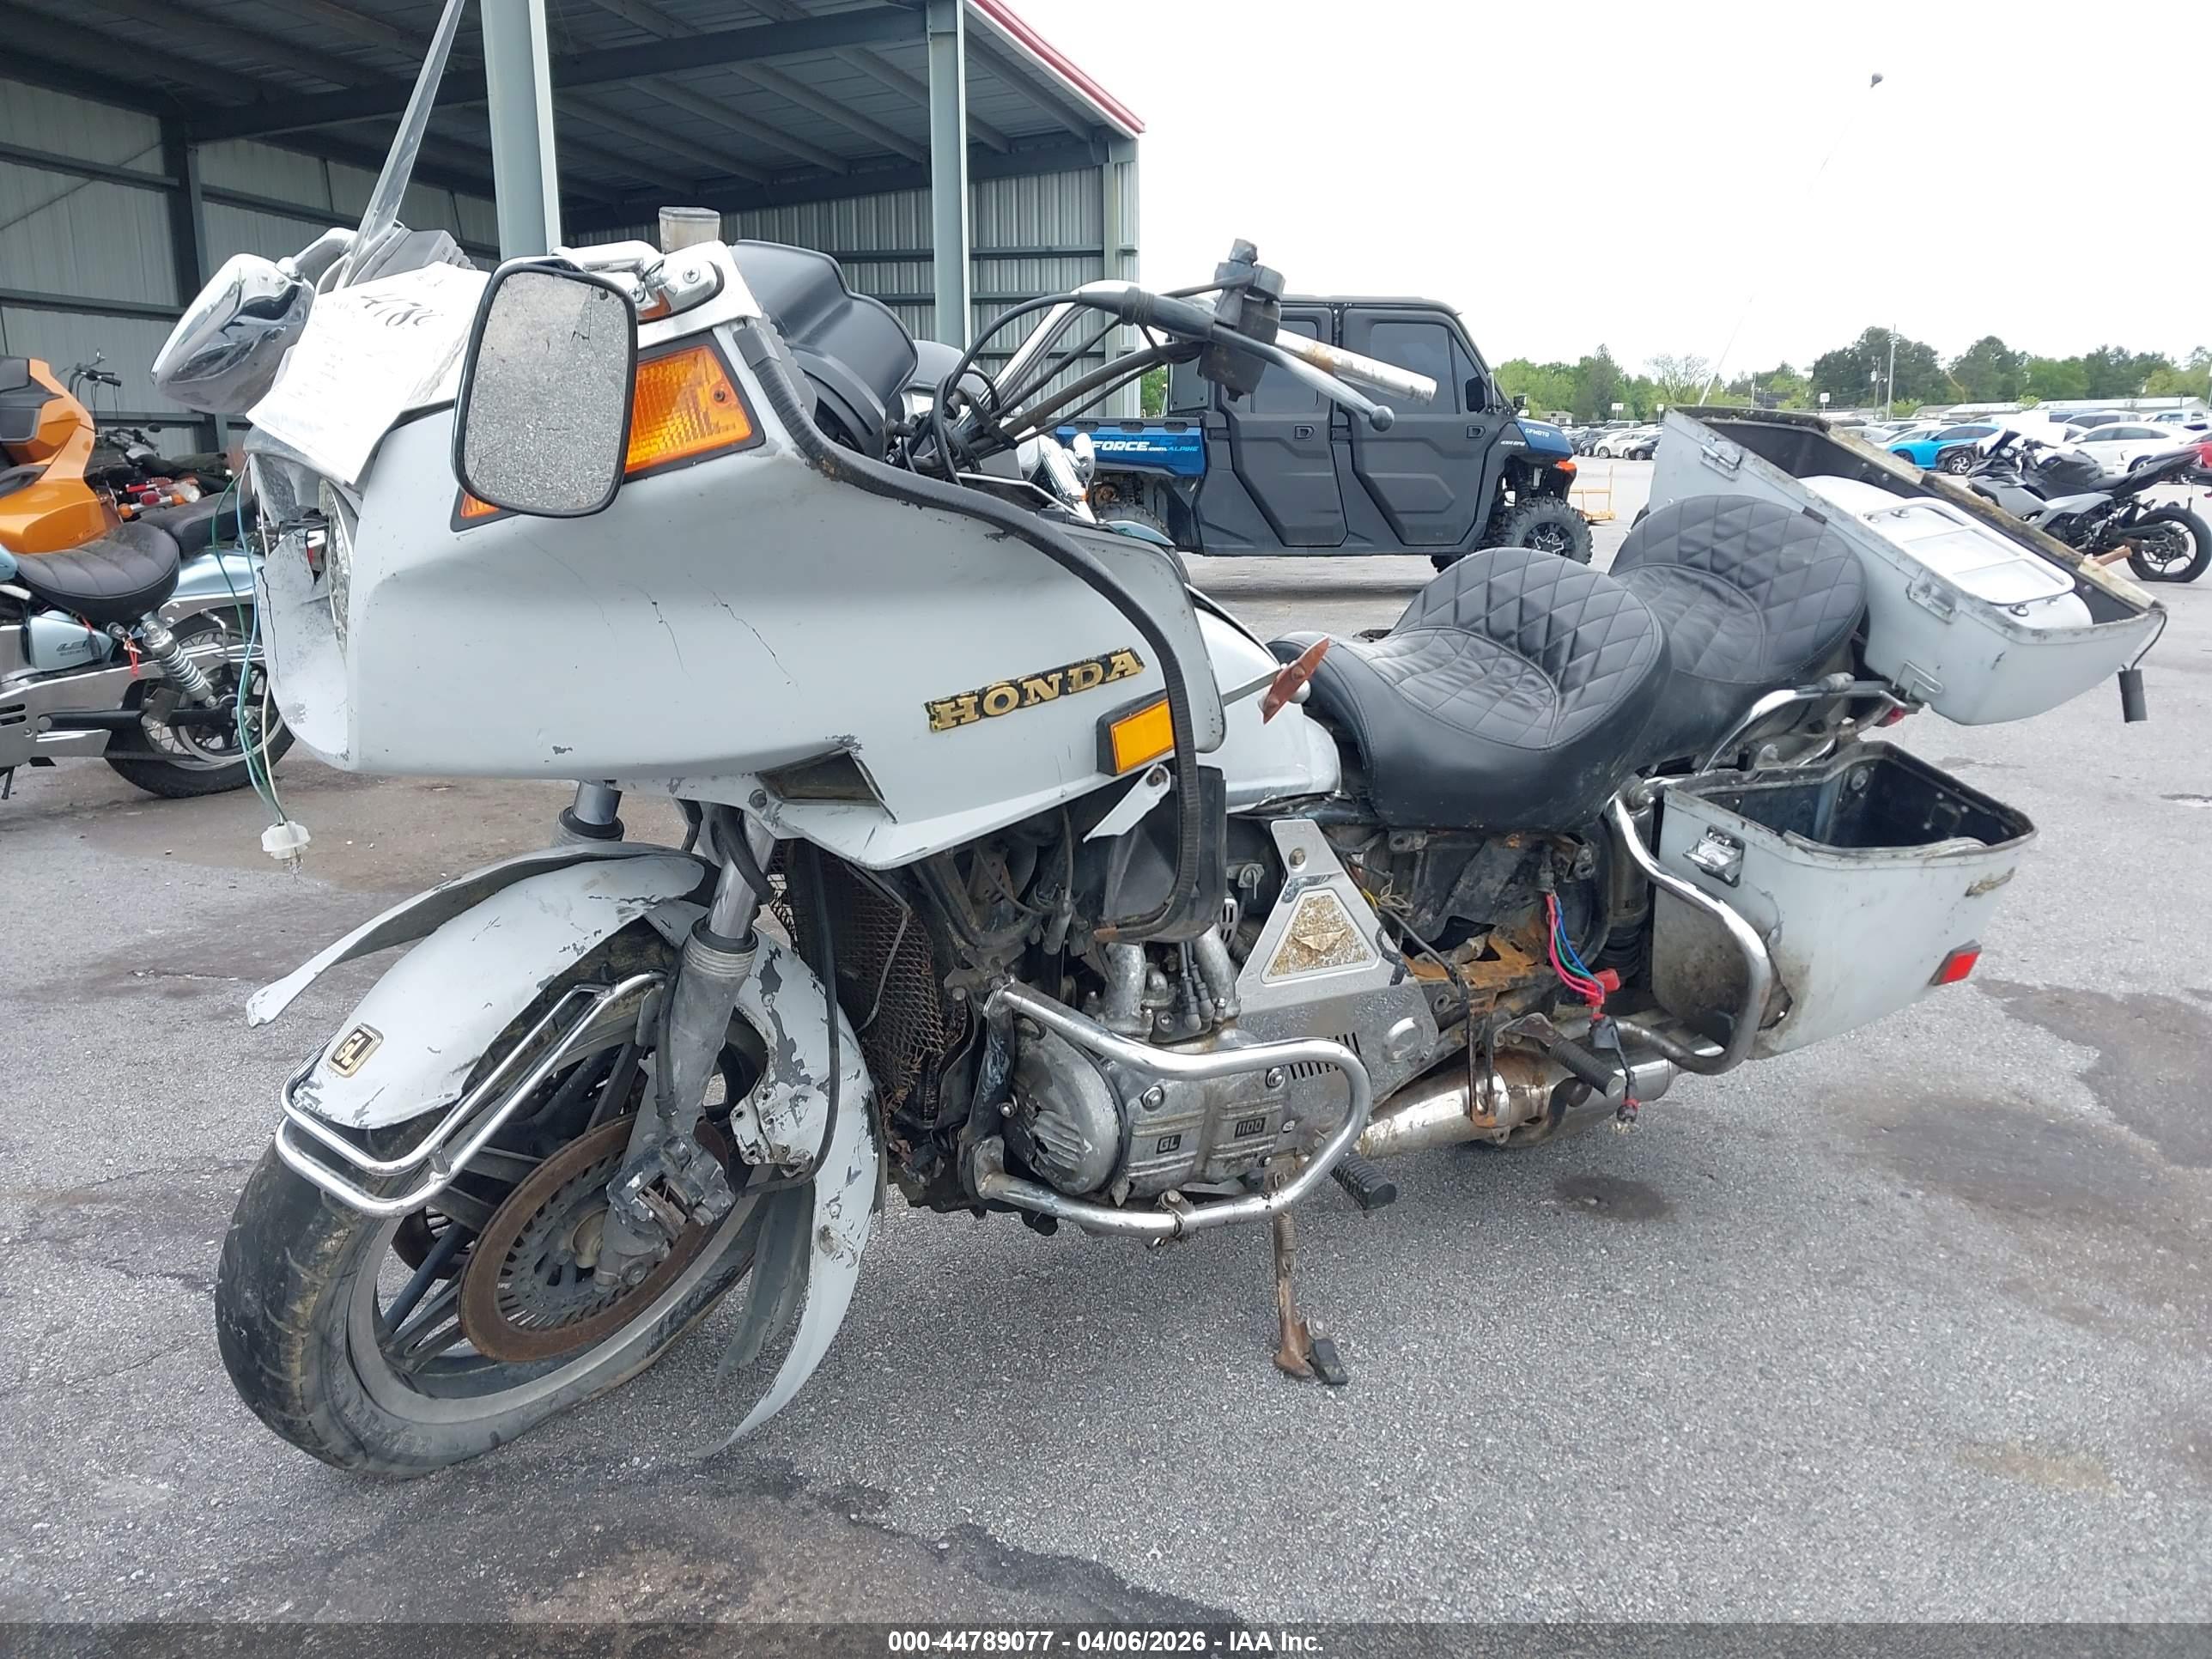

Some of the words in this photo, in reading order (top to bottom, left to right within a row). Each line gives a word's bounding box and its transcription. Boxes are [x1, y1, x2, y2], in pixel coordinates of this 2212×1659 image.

[933, 650, 1143, 730] HONDA
[334, 1031, 367, 1066] GL
[1237, 1119, 1264, 1137] 1100
[1158, 1135, 1180, 1153] GL
